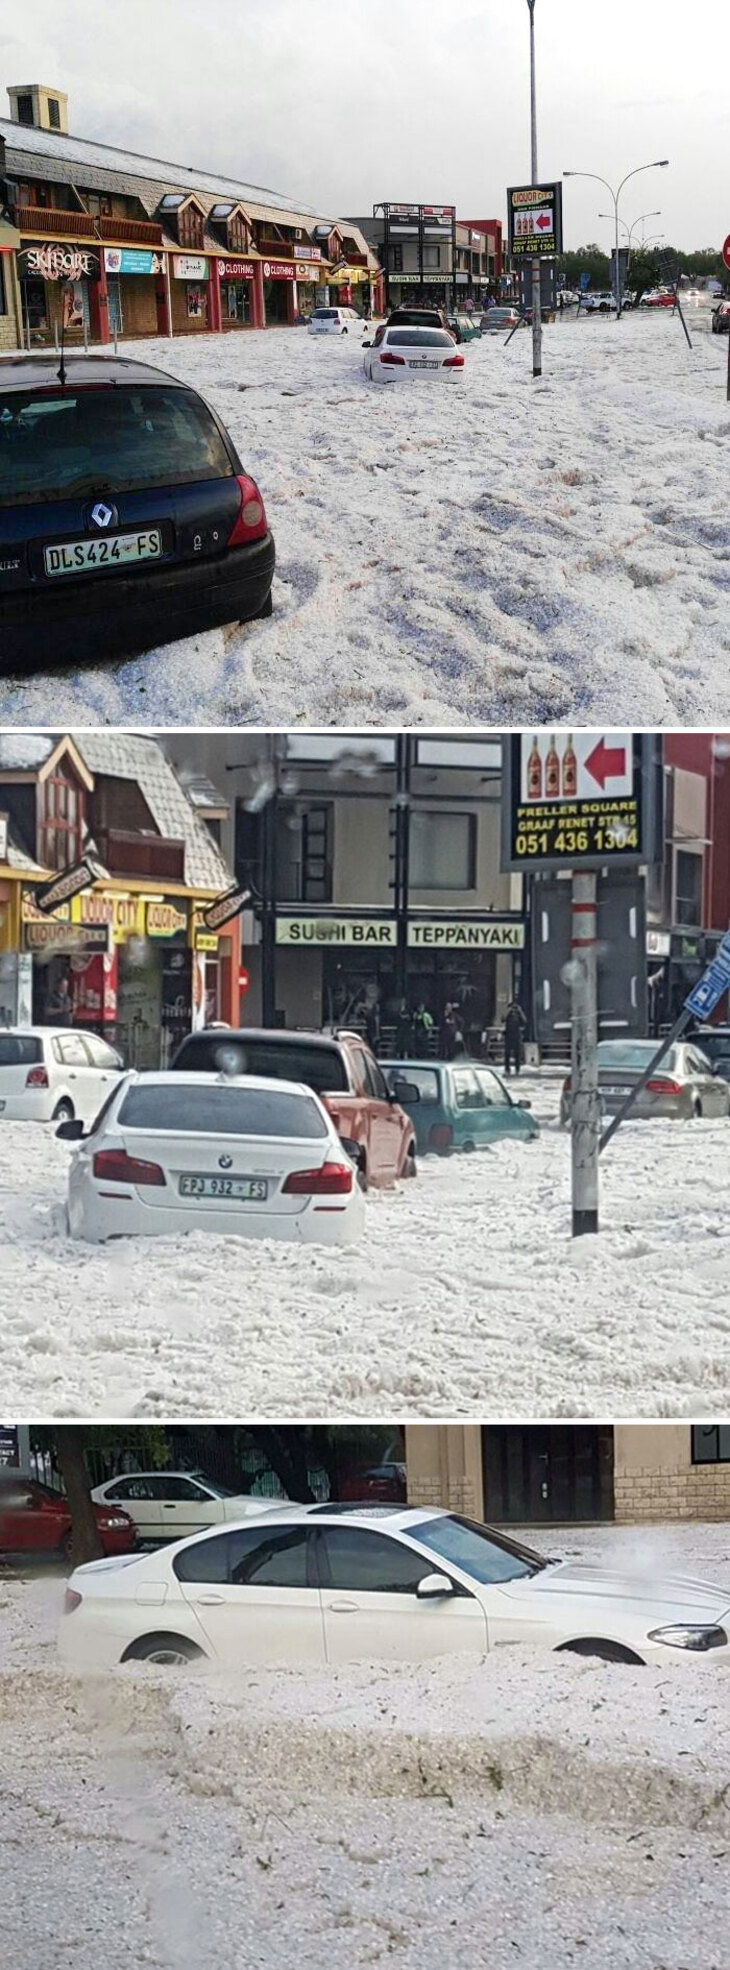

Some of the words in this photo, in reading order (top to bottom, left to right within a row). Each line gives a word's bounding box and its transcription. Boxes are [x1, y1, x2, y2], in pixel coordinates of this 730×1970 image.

[513, 191, 537, 204] LIQUOR
[512, 245, 525, 254] 051
[540, 243, 555, 251] 1304
[225, 263, 254, 275] CLOTHING
[270, 265, 294, 276] CLOTHING
[49, 540, 121, 571] DLS424
[137, 533, 159, 555] FS
[517, 805, 578, 817] PRELLER
[581, 801, 637, 813] SQUARE
[518, 820, 556, 832] GRAAF
[558, 817, 596, 829] RENET
[624, 814, 637, 825] 15
[516, 833, 548, 854] 051
[554, 831, 588, 852] 436
[594, 828, 638, 850] 1304
[117, 900, 138, 926] CITY
[29, 924, 73, 943] LIQUOR
[289, 923, 346, 941] SUSHI
[352, 925, 392, 942] BAR
[412, 926, 519, 945] TEPPANYAKI
[183, 1176, 205, 1193] FPJ
[211, 1178, 233, 1195] 932
[249, 1180, 265, 1198] FS
